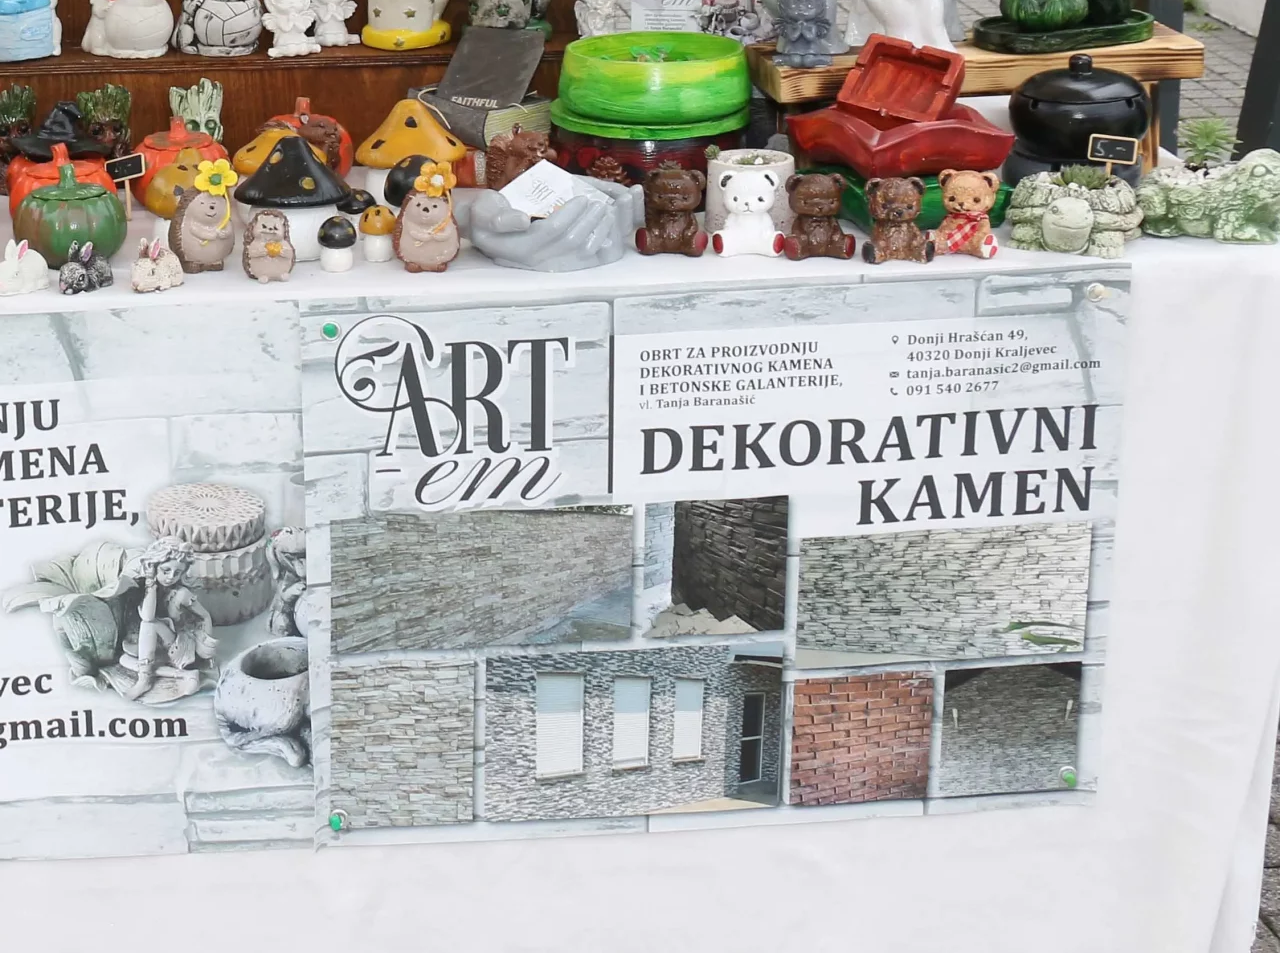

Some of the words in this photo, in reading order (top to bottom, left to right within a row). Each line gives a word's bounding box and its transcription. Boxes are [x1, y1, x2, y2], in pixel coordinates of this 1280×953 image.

[907, 332, 944, 346] Donji
[948, 330, 1003, 344] Hrašćan
[1007, 329, 1028, 342] 49,
[640, 348, 682, 362] OBRT
[687, 346, 706, 359] ZA
[711, 341, 819, 358] PROIZVODNJU
[907, 349, 950, 362] 40320
[954, 348, 991, 361] Donji
[995, 345, 1058, 359] Kraljevec
[640, 362, 763, 379] DEKORATIVNOG
[768, 357, 834, 373] KAMENA
[907, 359, 1101, 380] tanja.baranasic2@gmail.com
[335, 315, 569, 458] ART
[650, 379, 732, 396] BETONSKE
[736, 374, 844, 392] GALANTERIJE,
[906, 384, 931, 396] 091
[936, 383, 962, 394] 540
[965, 380, 999, 393] 2677
[639, 400, 653, 410] vl.
[656, 398, 690, 410] Tanja
[693, 395, 756, 407] Baranašić
[639, 404, 1100, 475] DEKORATIVNI
[856, 466, 1096, 526] KAMEN
